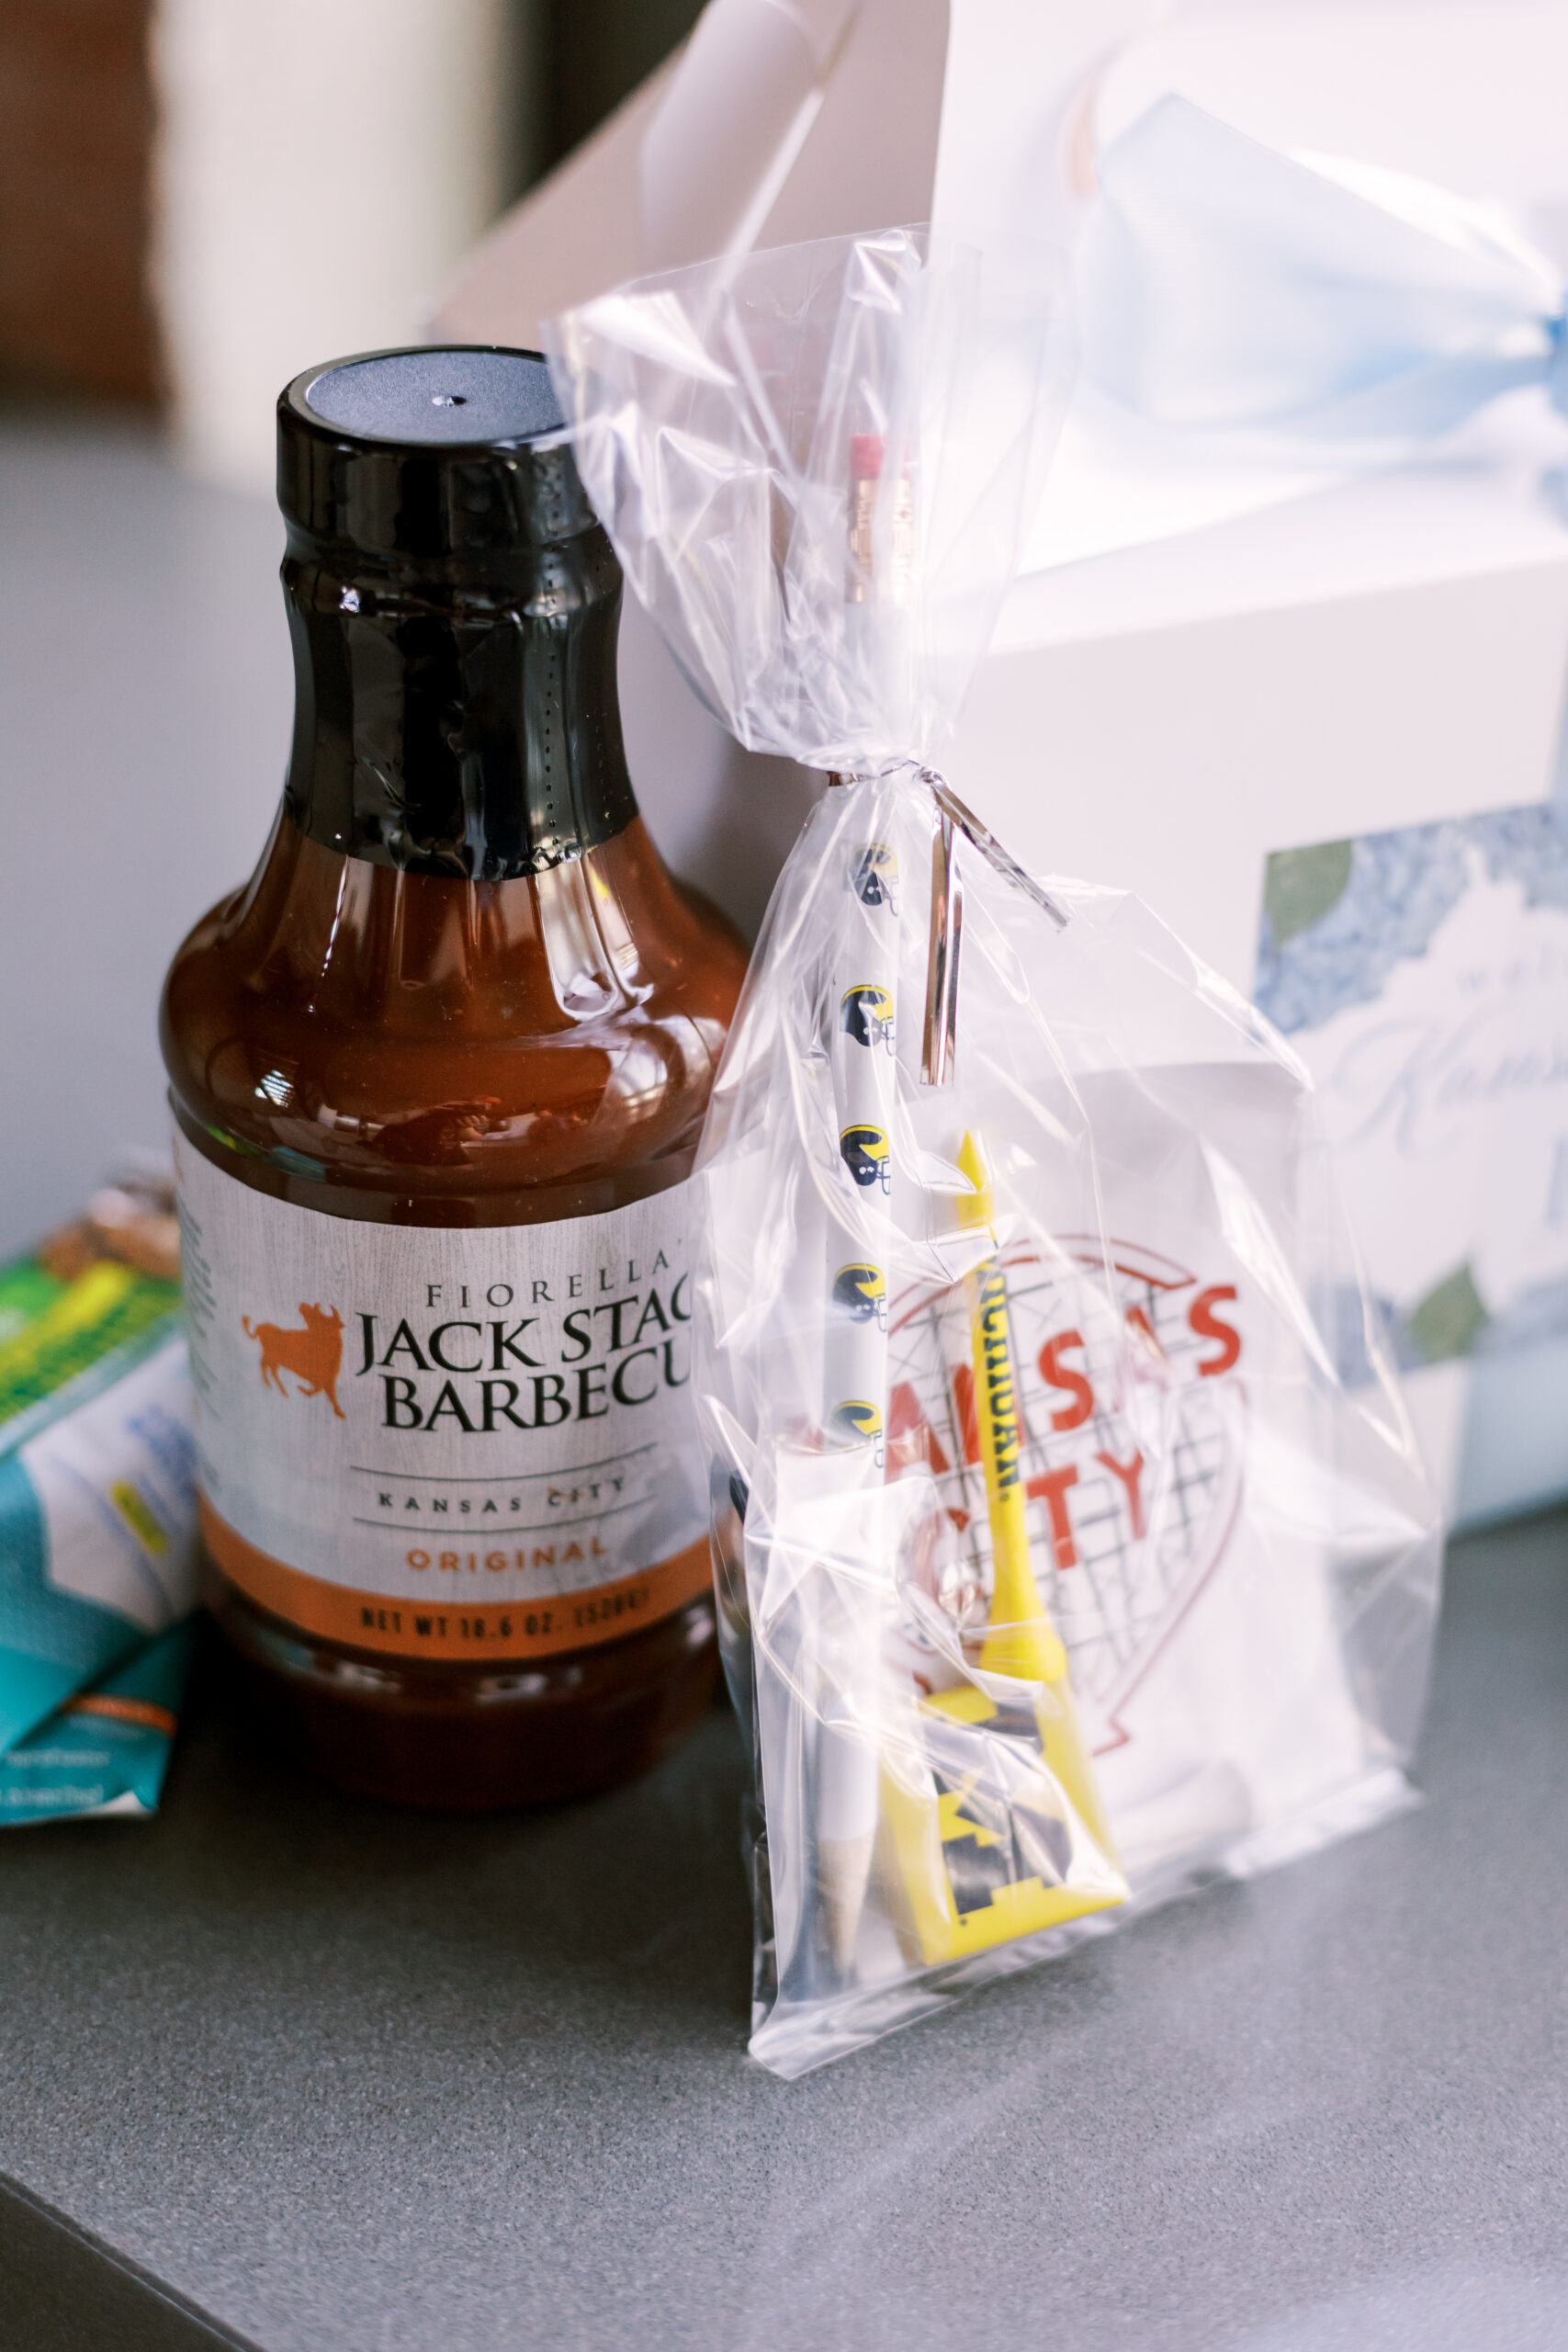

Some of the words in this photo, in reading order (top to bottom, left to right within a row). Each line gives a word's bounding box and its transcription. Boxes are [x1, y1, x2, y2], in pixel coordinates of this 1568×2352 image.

[425, 1238, 682, 1309] FIORELLA'
[355, 1311, 547, 1377] JACK
[560, 1271, 692, 1363] STAC
[378, 1336, 692, 1434] BARBECU
[378, 1492, 522, 1514] KANSAS
[547, 1476, 624, 1508] CITY
[405, 1535, 611, 1574] ORIGINAL
[361, 1606, 401, 1634] NET
[414, 1615, 448, 1638] WT
